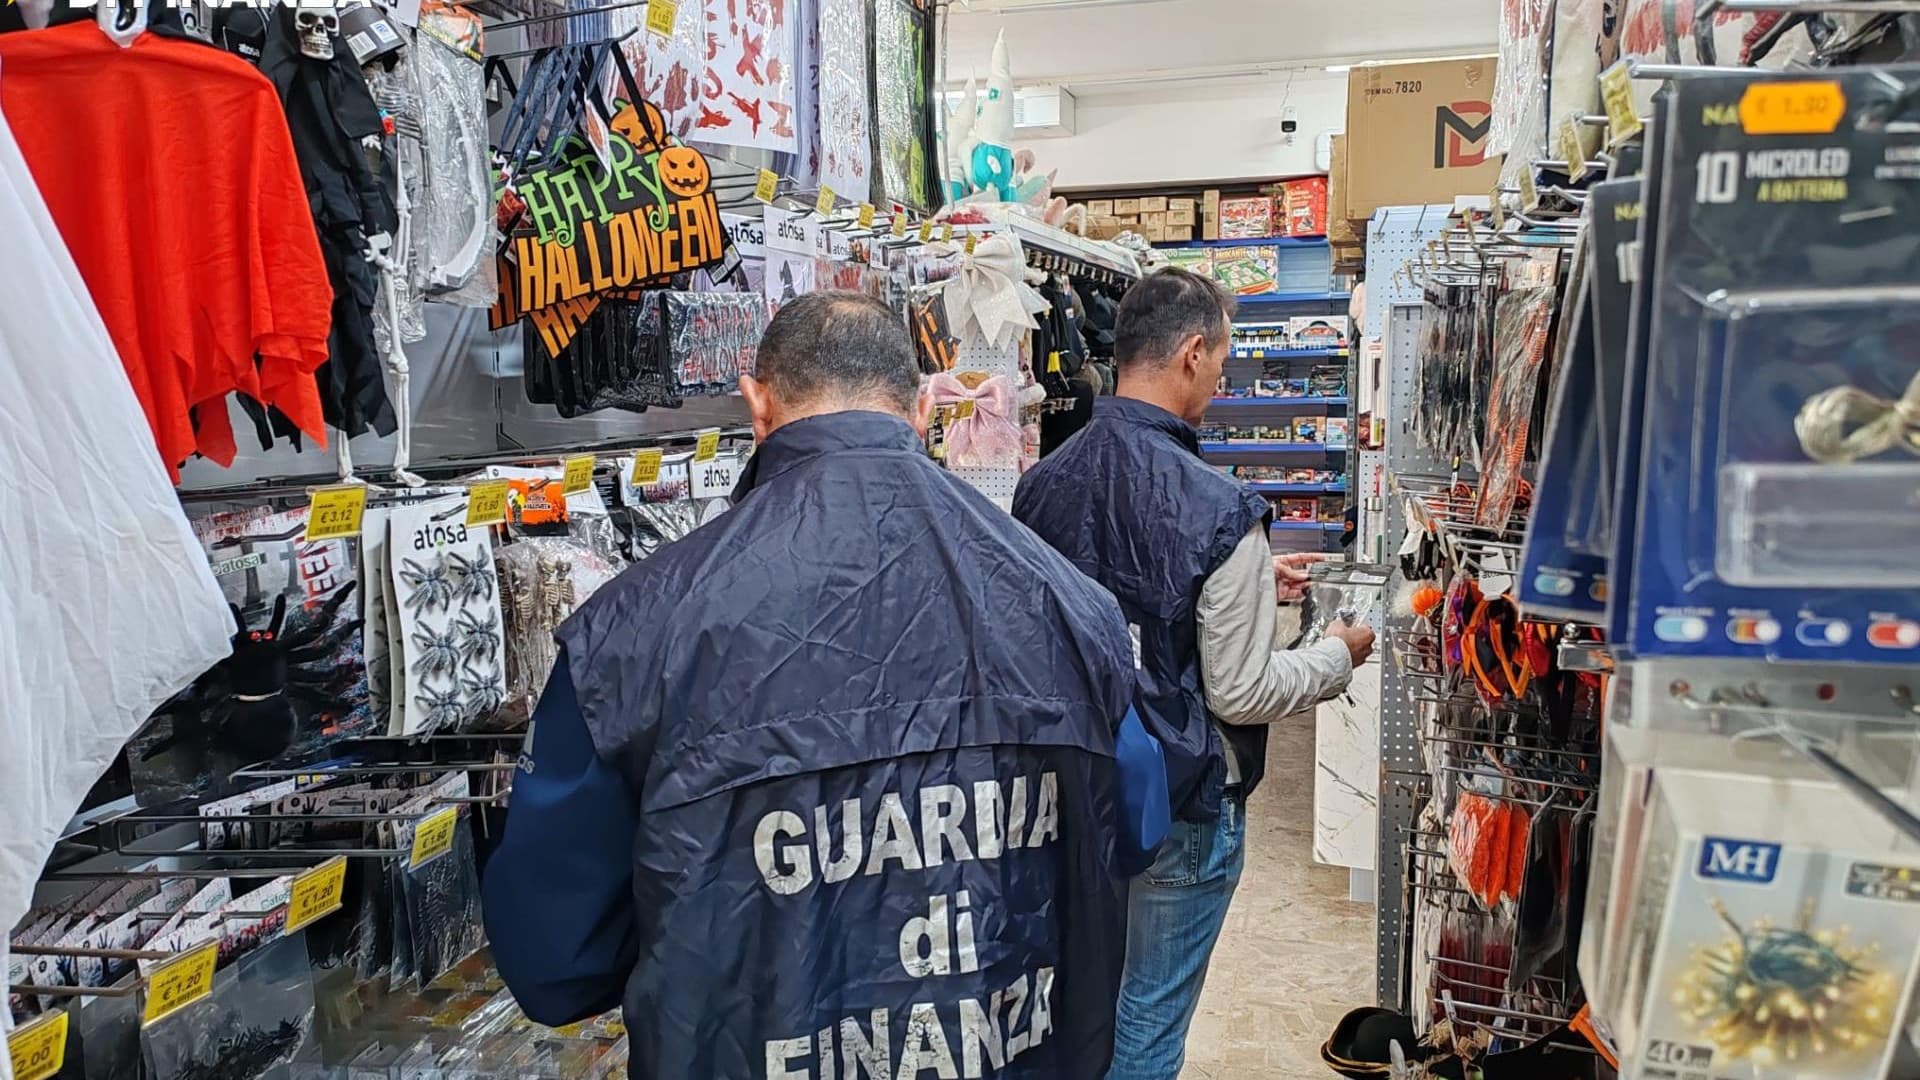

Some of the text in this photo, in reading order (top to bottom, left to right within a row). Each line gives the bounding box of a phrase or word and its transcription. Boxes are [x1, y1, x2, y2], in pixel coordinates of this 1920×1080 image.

[1395, 80, 1422, 94] 7820
[1696, 152, 1740, 204] 10
[1745, 148, 1850, 179] MICROLED
[519, 133, 669, 248] HAPPY
[1756, 178, 1848, 202] A BATTERIA
[729, 223, 764, 245] atosa
[778, 220, 805, 241] atosa
[517, 193, 723, 313] HALLOWEEN
[704, 465, 730, 488] atosa
[321, 508, 353, 524] € 3.12
[414, 523, 468, 550] atosa
[222, 555, 261, 573] atosa
[754, 772, 1058, 895] GUARDIA
[1706, 842, 1773, 877] MH
[312, 884, 335, 903] 1.20
[900, 890, 979, 978] di
[176, 971, 203, 993] 1.20
[765, 966, 1055, 1080] FINANZA
[16, 1045, 51, 1074] 2.00
[1645, 1040, 1691, 1065] 40
